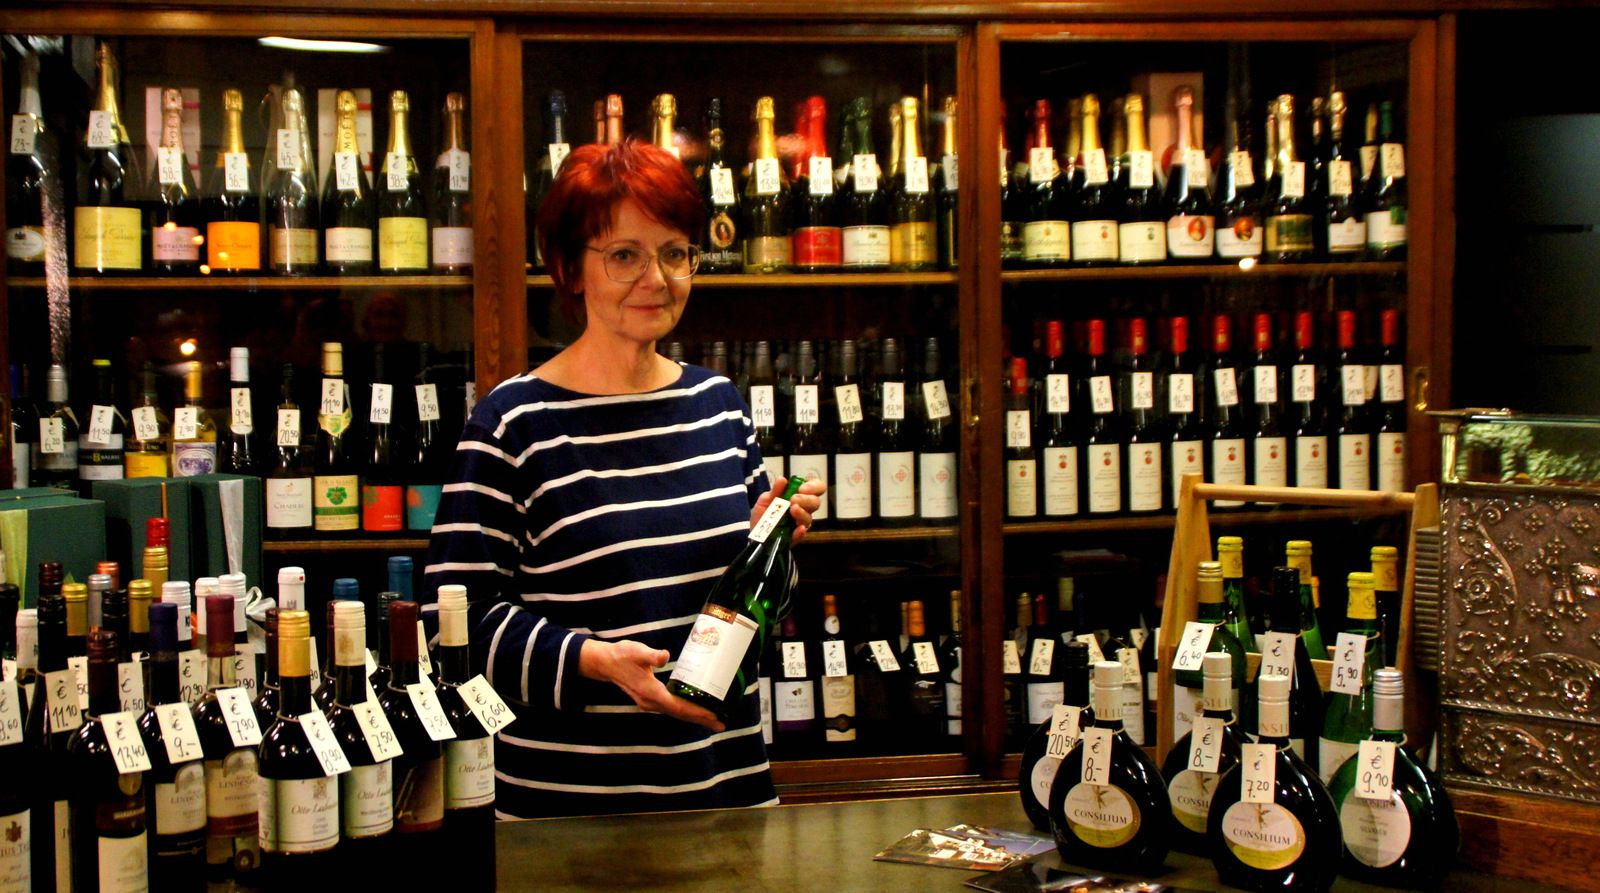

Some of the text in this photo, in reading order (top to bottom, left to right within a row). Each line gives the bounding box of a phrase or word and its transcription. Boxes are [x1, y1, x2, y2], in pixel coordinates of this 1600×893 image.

[228, 173, 246, 188] 56.-
[339, 173, 357, 187] 42.-
[372, 408, 390, 421] 11.50
[421, 402, 438, 417] 9.50
[754, 408, 773, 422] 11.50
[279, 429, 300, 443] 20.50
[1178, 651, 1202, 667] 6.40
[1272, 645, 1281, 657] €
[121, 679, 131, 693] €
[1336, 665, 1358, 688] 5.90
[180, 682, 204, 704] 12.90
[52, 704, 78, 730] 11.10
[480, 702, 507, 729] 6.60
[231, 718, 255, 742] 7.90
[173, 736, 197, 758] 9.-
[371, 731, 394, 755] 7.50
[1048, 732, 1076, 756] 20.50
[116, 744, 146, 769] 13.40
[321, 747, 342, 773] 8.90
[1193, 747, 1214, 768] 8.-
[1084, 757, 1103, 782] 8.-
[1245, 779, 1270, 799] 7.20
[1362, 770, 1389, 795] 9.10
[1073, 808, 1128, 825] CONSILIUM
[1232, 828, 1291, 847] CONSILIUM
